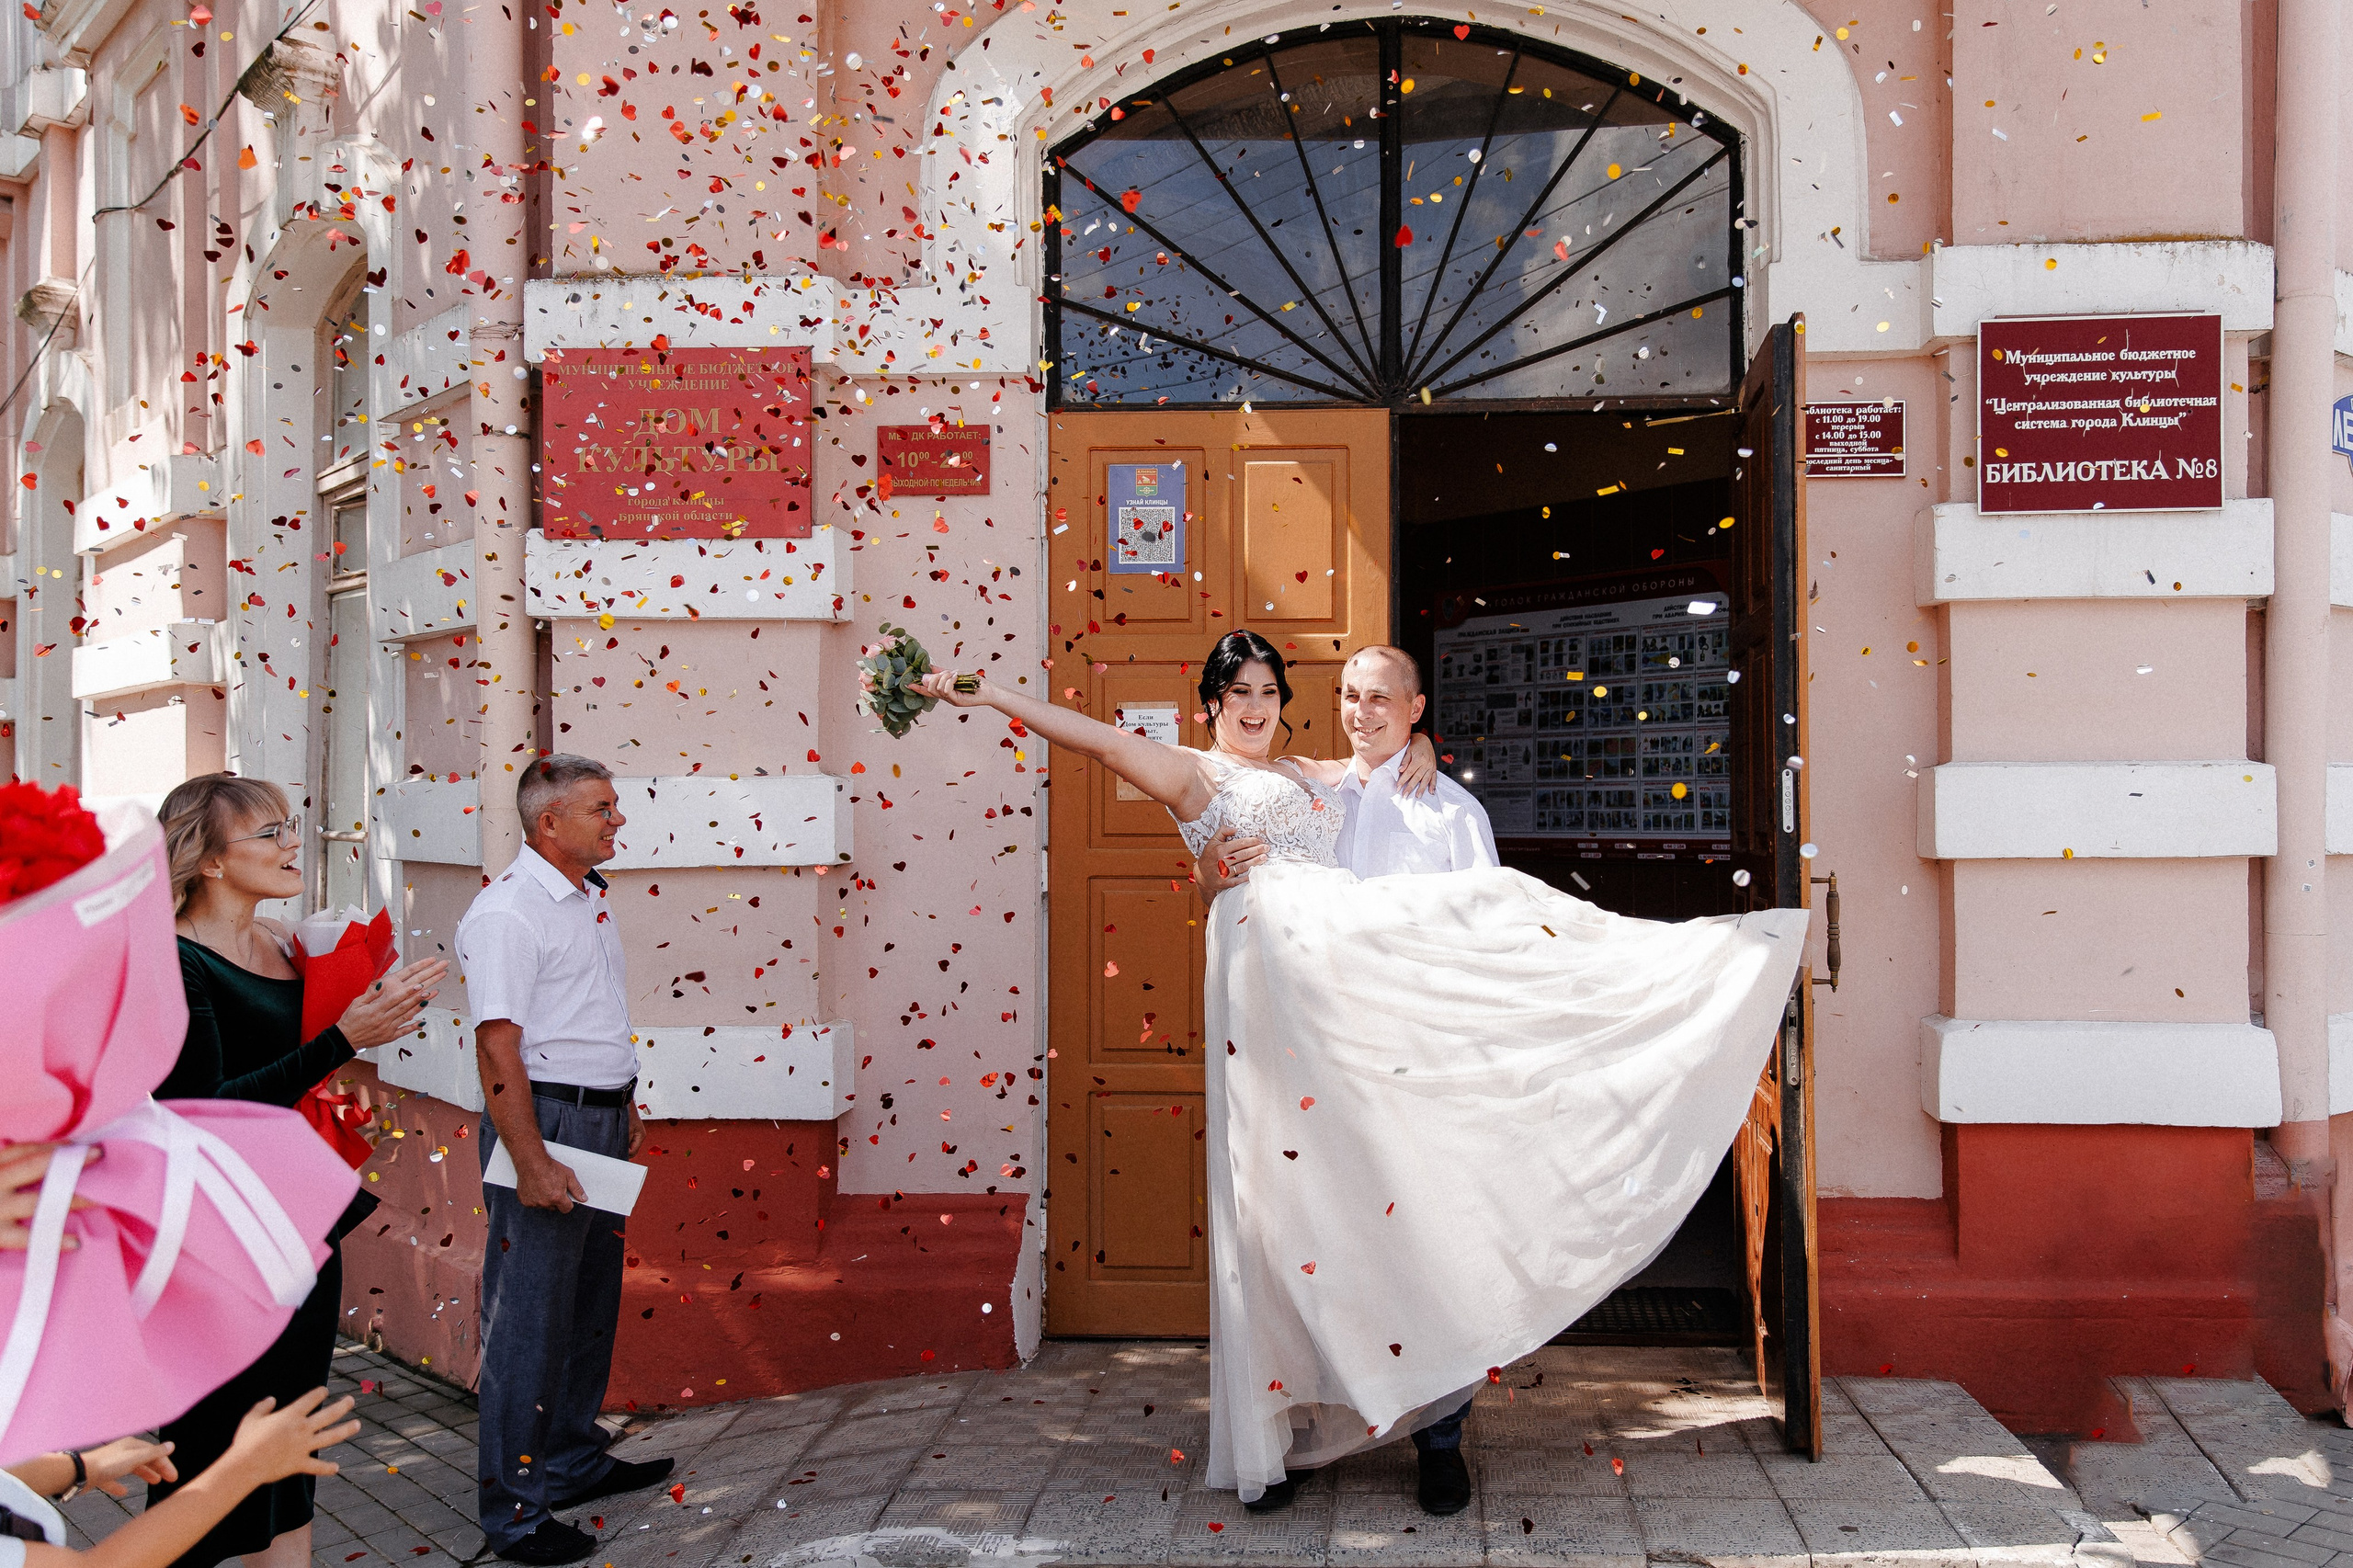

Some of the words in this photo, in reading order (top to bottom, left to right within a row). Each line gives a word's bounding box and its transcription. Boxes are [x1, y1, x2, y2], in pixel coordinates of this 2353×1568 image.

[2006, 350, 2115, 366] Муниципальное
[2120, 348, 2197, 361] бюджетное
[2024, 371, 2107, 385] учреждение
[2111, 370, 2177, 382] культуры
[2125, 396, 2217, 408] библиотечная
[1856, 405, 1902, 415] работает:
[632, 407, 722, 441] ДОМ
[1822, 415, 1844, 424] 11.00
[1858, 415, 1881, 423] 19.00
[2014, 419, 2067, 429] система
[2071, 418, 2117, 430] города
[912, 432, 925, 442] ДК
[926, 431, 982, 440] РАБОТАЕТ:
[1822, 431, 1845, 439] 14.00
[1859, 430, 1881, 438] 15.00
[576, 446, 780, 473] КУЛЬТУРЫ
[1985, 460, 2170, 483] БИБЛИОТЕКА
[627, 497, 669, 508] города
[683, 510, 733, 521] области
[1538, 584, 1626, 602] ГРАЖДАНСКОЙ
[1632, 576, 1695, 592] ОБОРОНЫ
